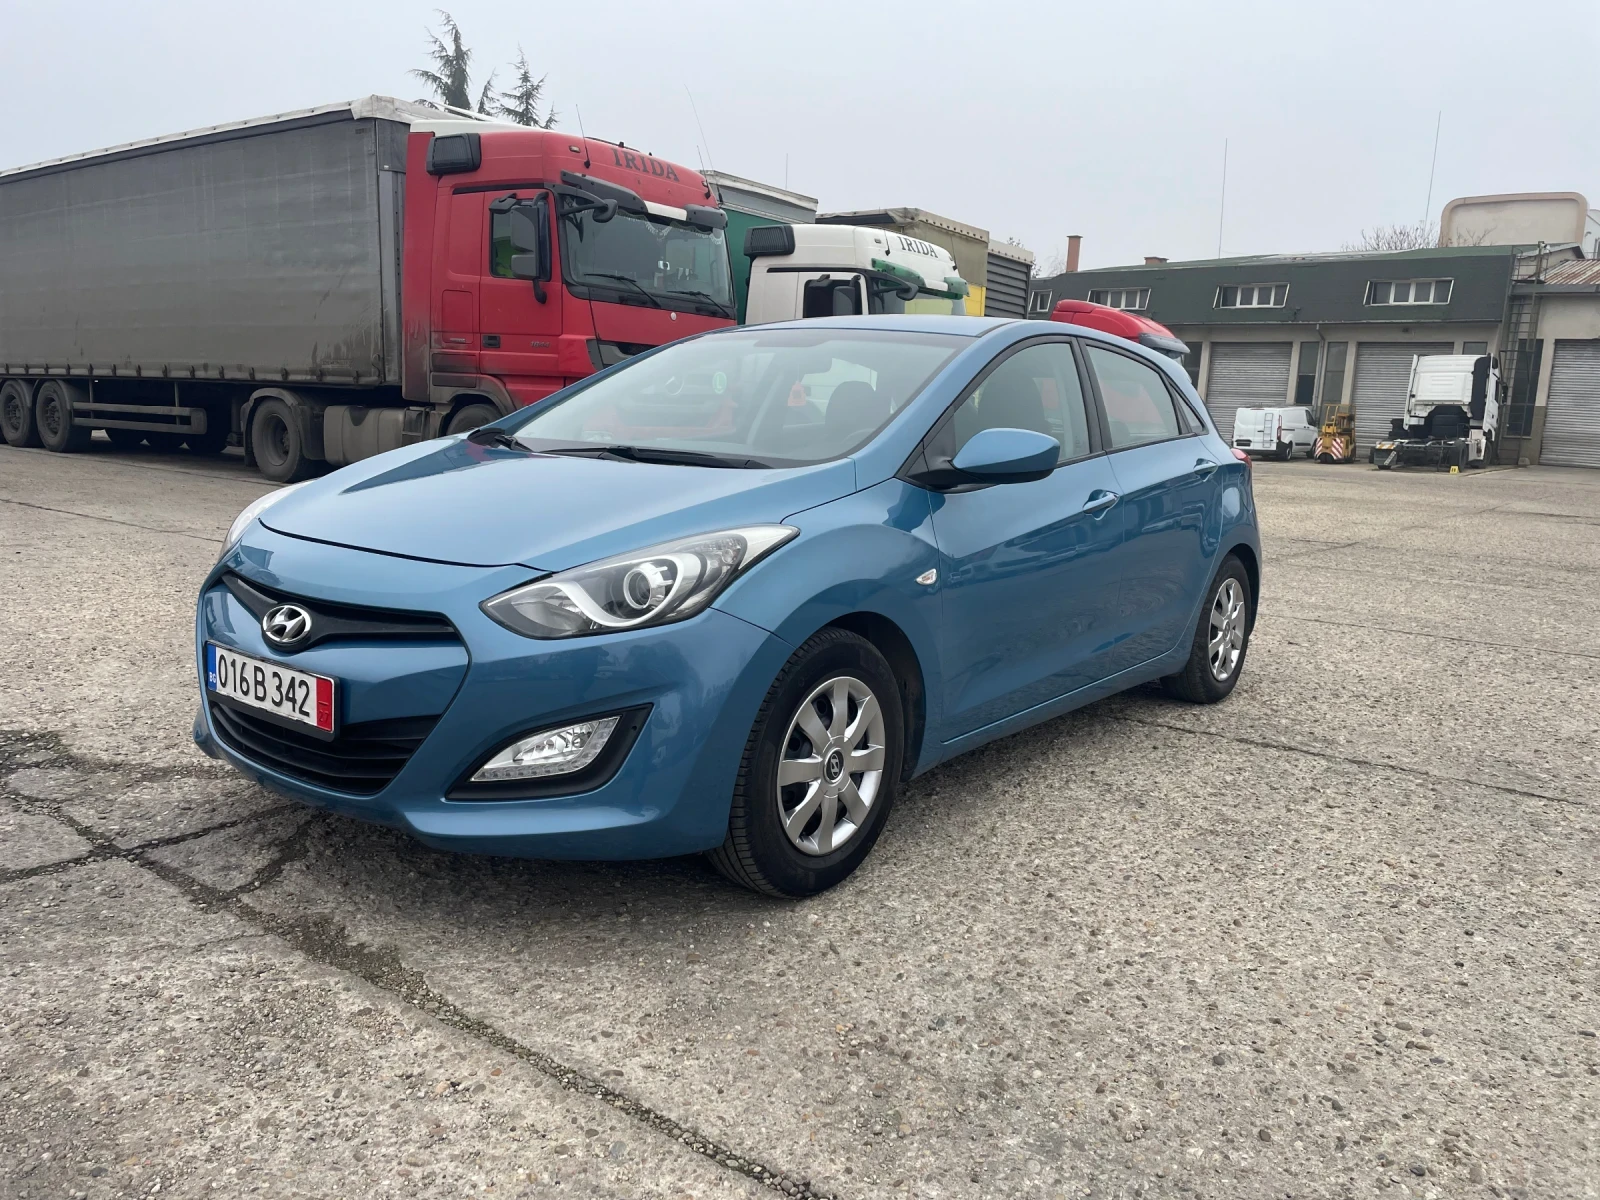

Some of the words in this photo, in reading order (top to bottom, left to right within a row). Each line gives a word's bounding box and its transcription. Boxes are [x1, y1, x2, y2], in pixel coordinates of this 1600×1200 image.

[611, 147, 680, 182] IRIDA
[896, 235, 939, 258] IRIDA
[209, 671, 217, 684] BG
